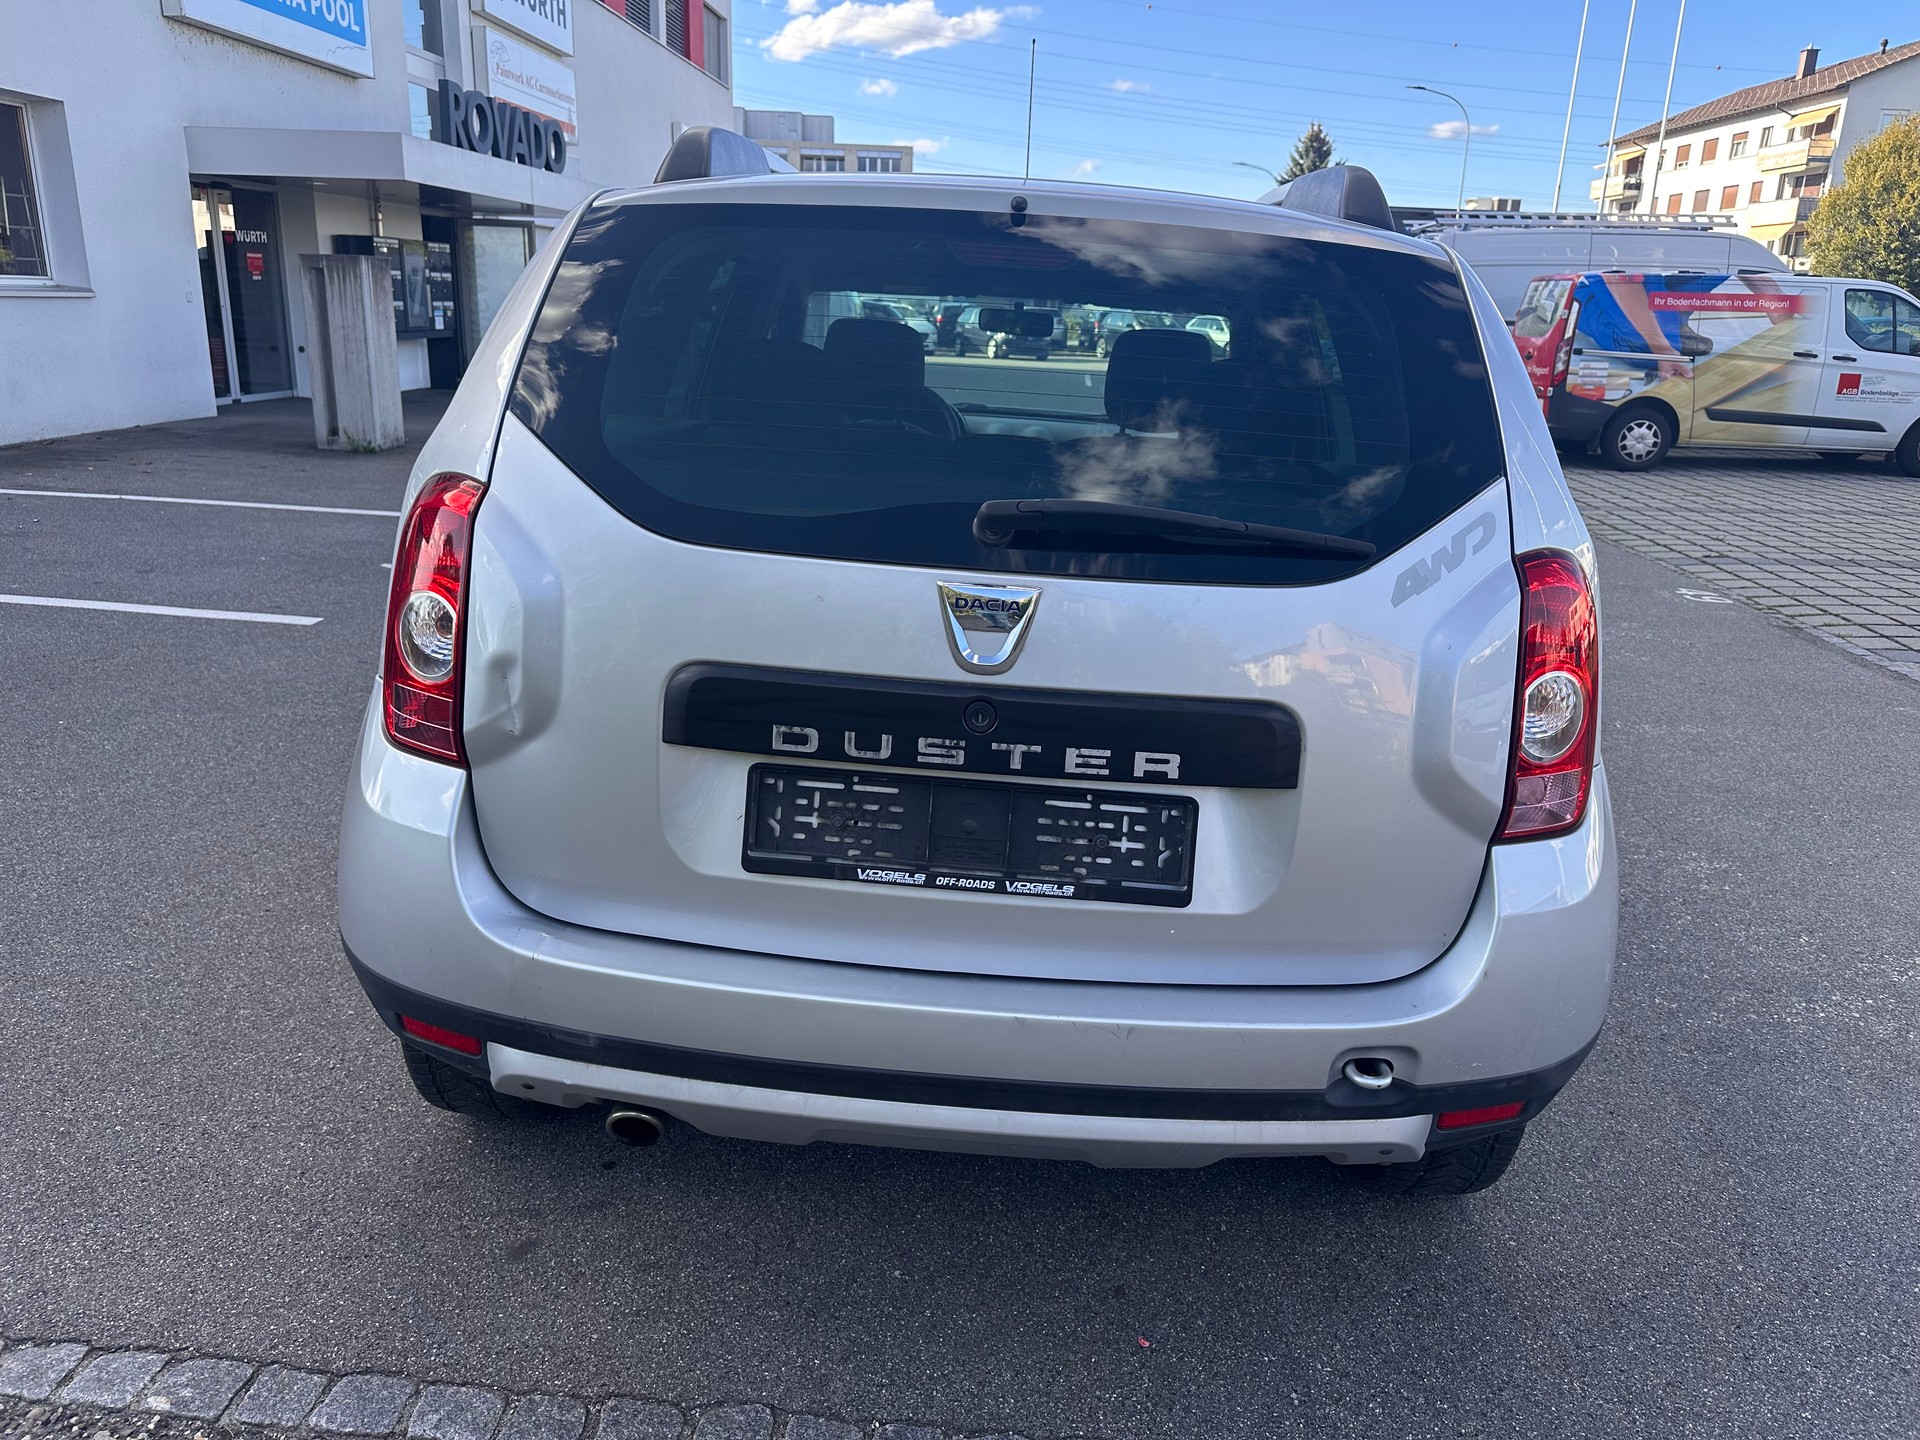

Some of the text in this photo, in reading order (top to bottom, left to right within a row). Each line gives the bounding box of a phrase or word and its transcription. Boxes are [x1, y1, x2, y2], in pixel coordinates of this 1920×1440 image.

[310, 0, 360, 33] POOL
[512, 0, 567, 30] RTH
[439, 79, 566, 175] ROVADO
[236, 230, 267, 243] WÜRTH
[1654, 297, 1790, 309] Ihr Bodenfachmann in der Region!
[1391, 511, 1497, 608] 4WD
[954, 597, 1021, 613] DACIA
[772, 724, 1181, 780] DUSTER
[857, 868, 1075, 893] VOGELS OFF-ROADS VOGELS
